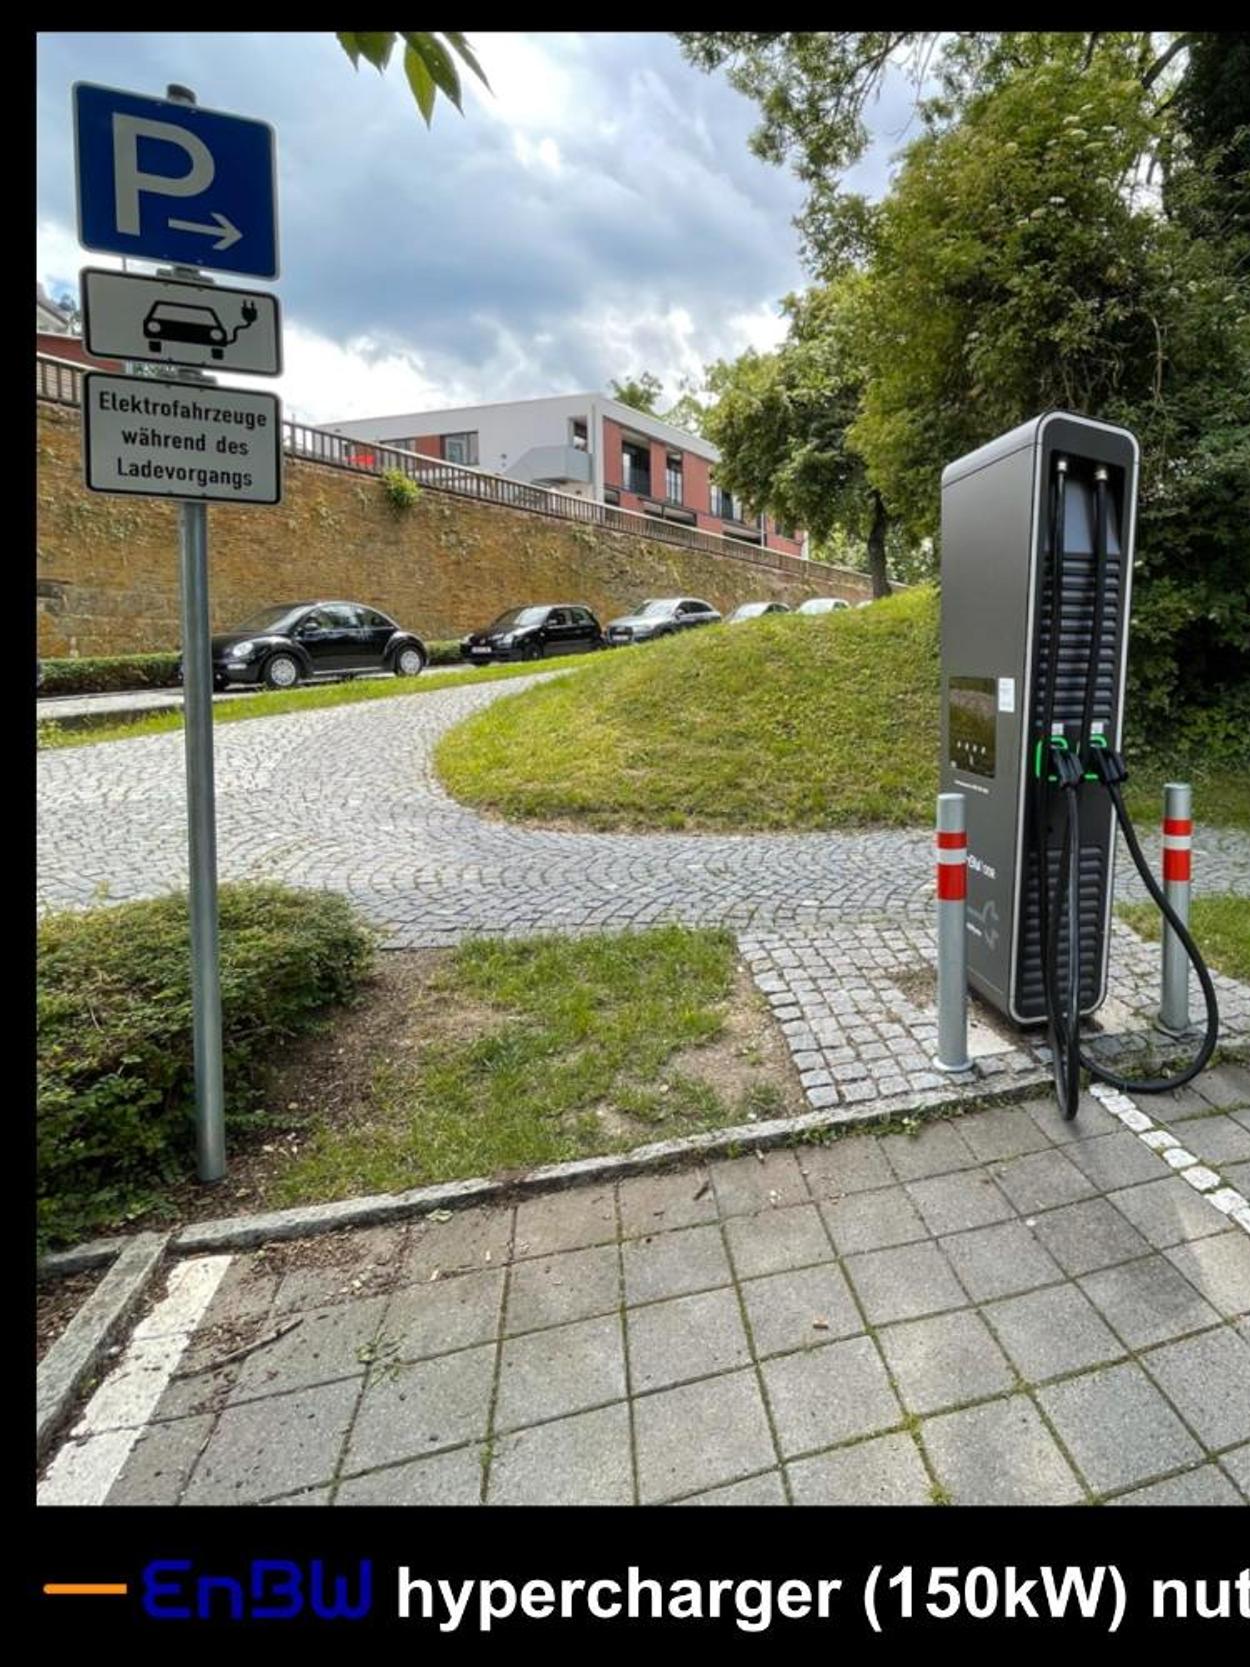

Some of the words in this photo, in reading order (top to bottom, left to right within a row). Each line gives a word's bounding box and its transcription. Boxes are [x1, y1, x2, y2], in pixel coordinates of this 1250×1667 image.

[112, 113, 216, 237] P
[99, 391, 267, 430] Elektrofahrzeuge
[122, 427, 206, 452] während
[216, 436, 250, 456] des
[117, 456, 253, 490] Ladevorgangs
